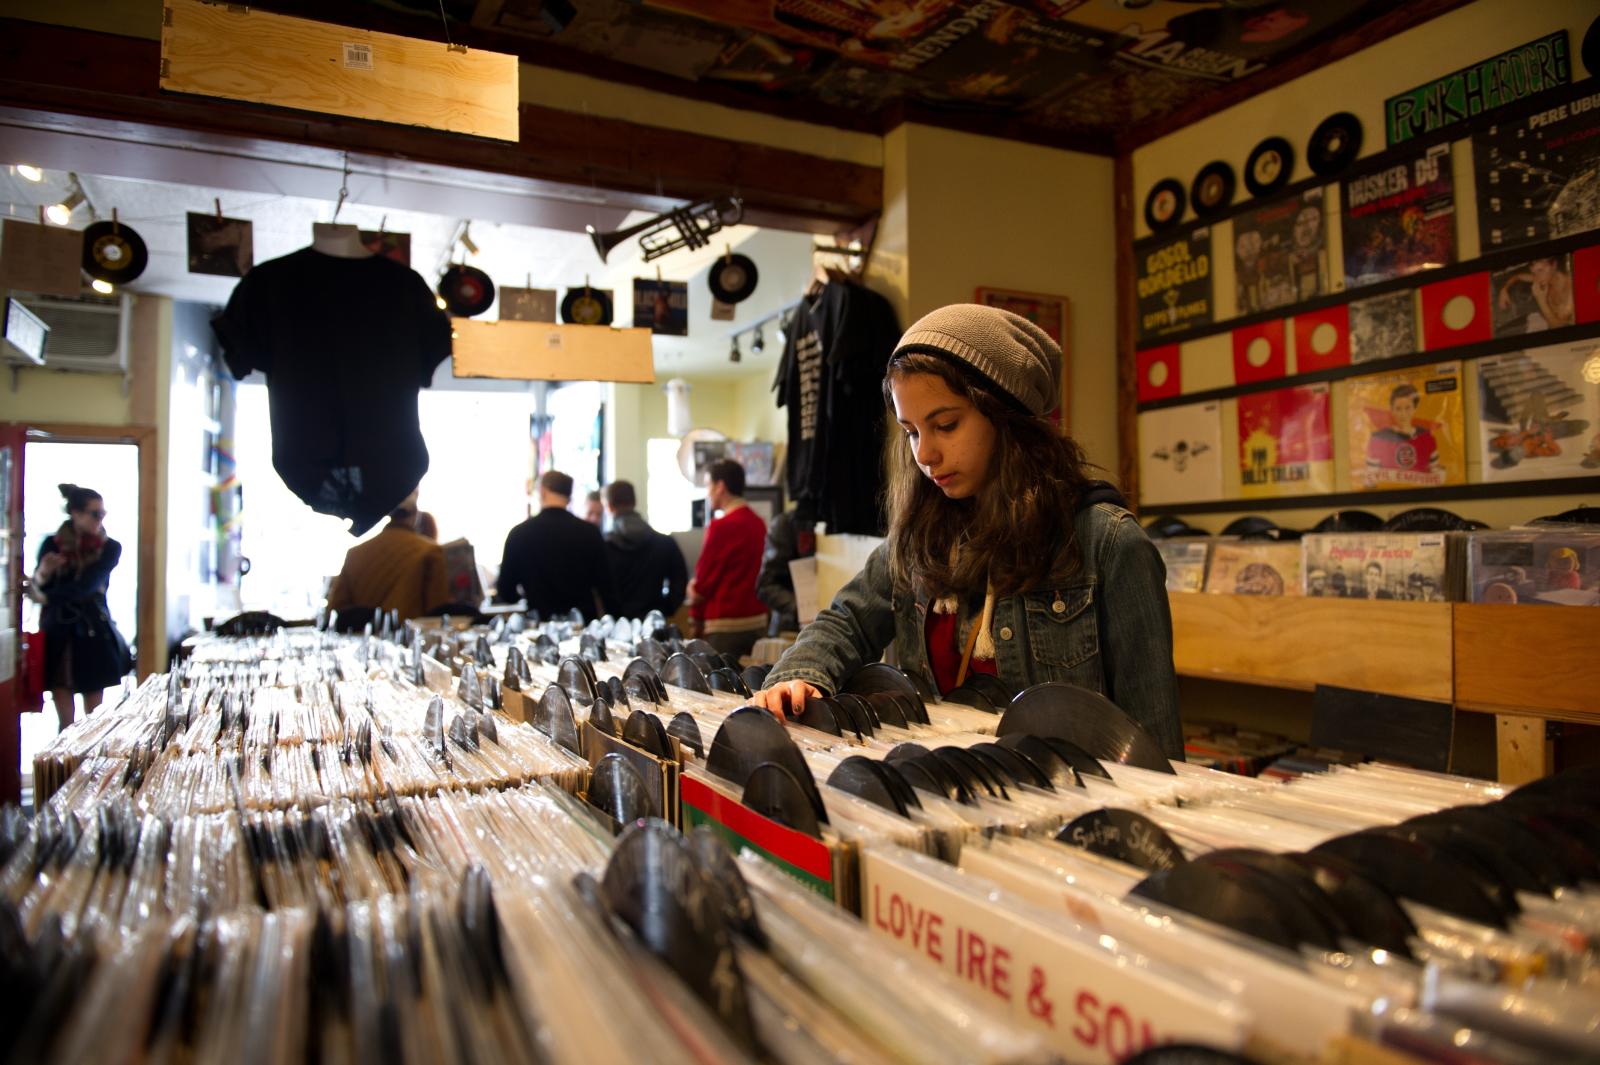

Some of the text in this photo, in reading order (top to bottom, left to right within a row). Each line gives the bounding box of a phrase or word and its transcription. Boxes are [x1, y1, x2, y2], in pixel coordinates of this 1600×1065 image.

[1390, 76, 1466, 143] PUNK
[1528, 92, 1600, 131] PERE UBU
[1137, 254, 1208, 299] BORDELLO
[1146, 240, 1191, 275] GOGOL
[1241, 467, 1268, 485] BILLY
[873, 883, 944, 964] LOVE
[956, 926, 1013, 1003] IRE
[1026, 963, 1057, 1031] &
[1072, 987, 1168, 1065] SO
